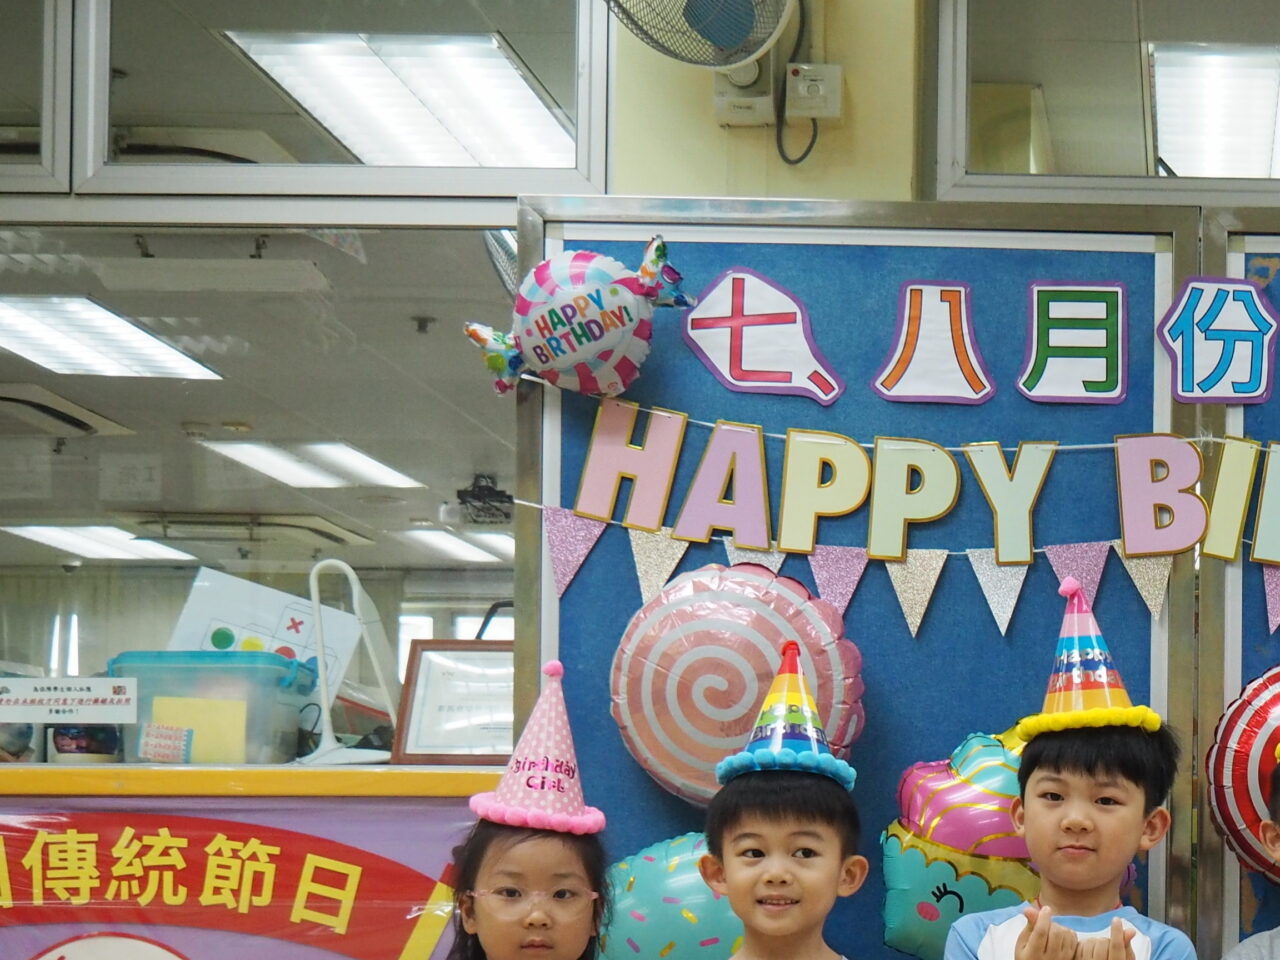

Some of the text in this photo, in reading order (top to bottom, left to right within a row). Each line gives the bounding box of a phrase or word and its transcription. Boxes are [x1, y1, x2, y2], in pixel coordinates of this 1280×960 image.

[532, 305, 634, 366] BIRTHDAY!
[534, 289, 605, 339] HAPPY
[573, 398, 1059, 565] HAPPY
[0, 826, 363, 936] 傳統節日
